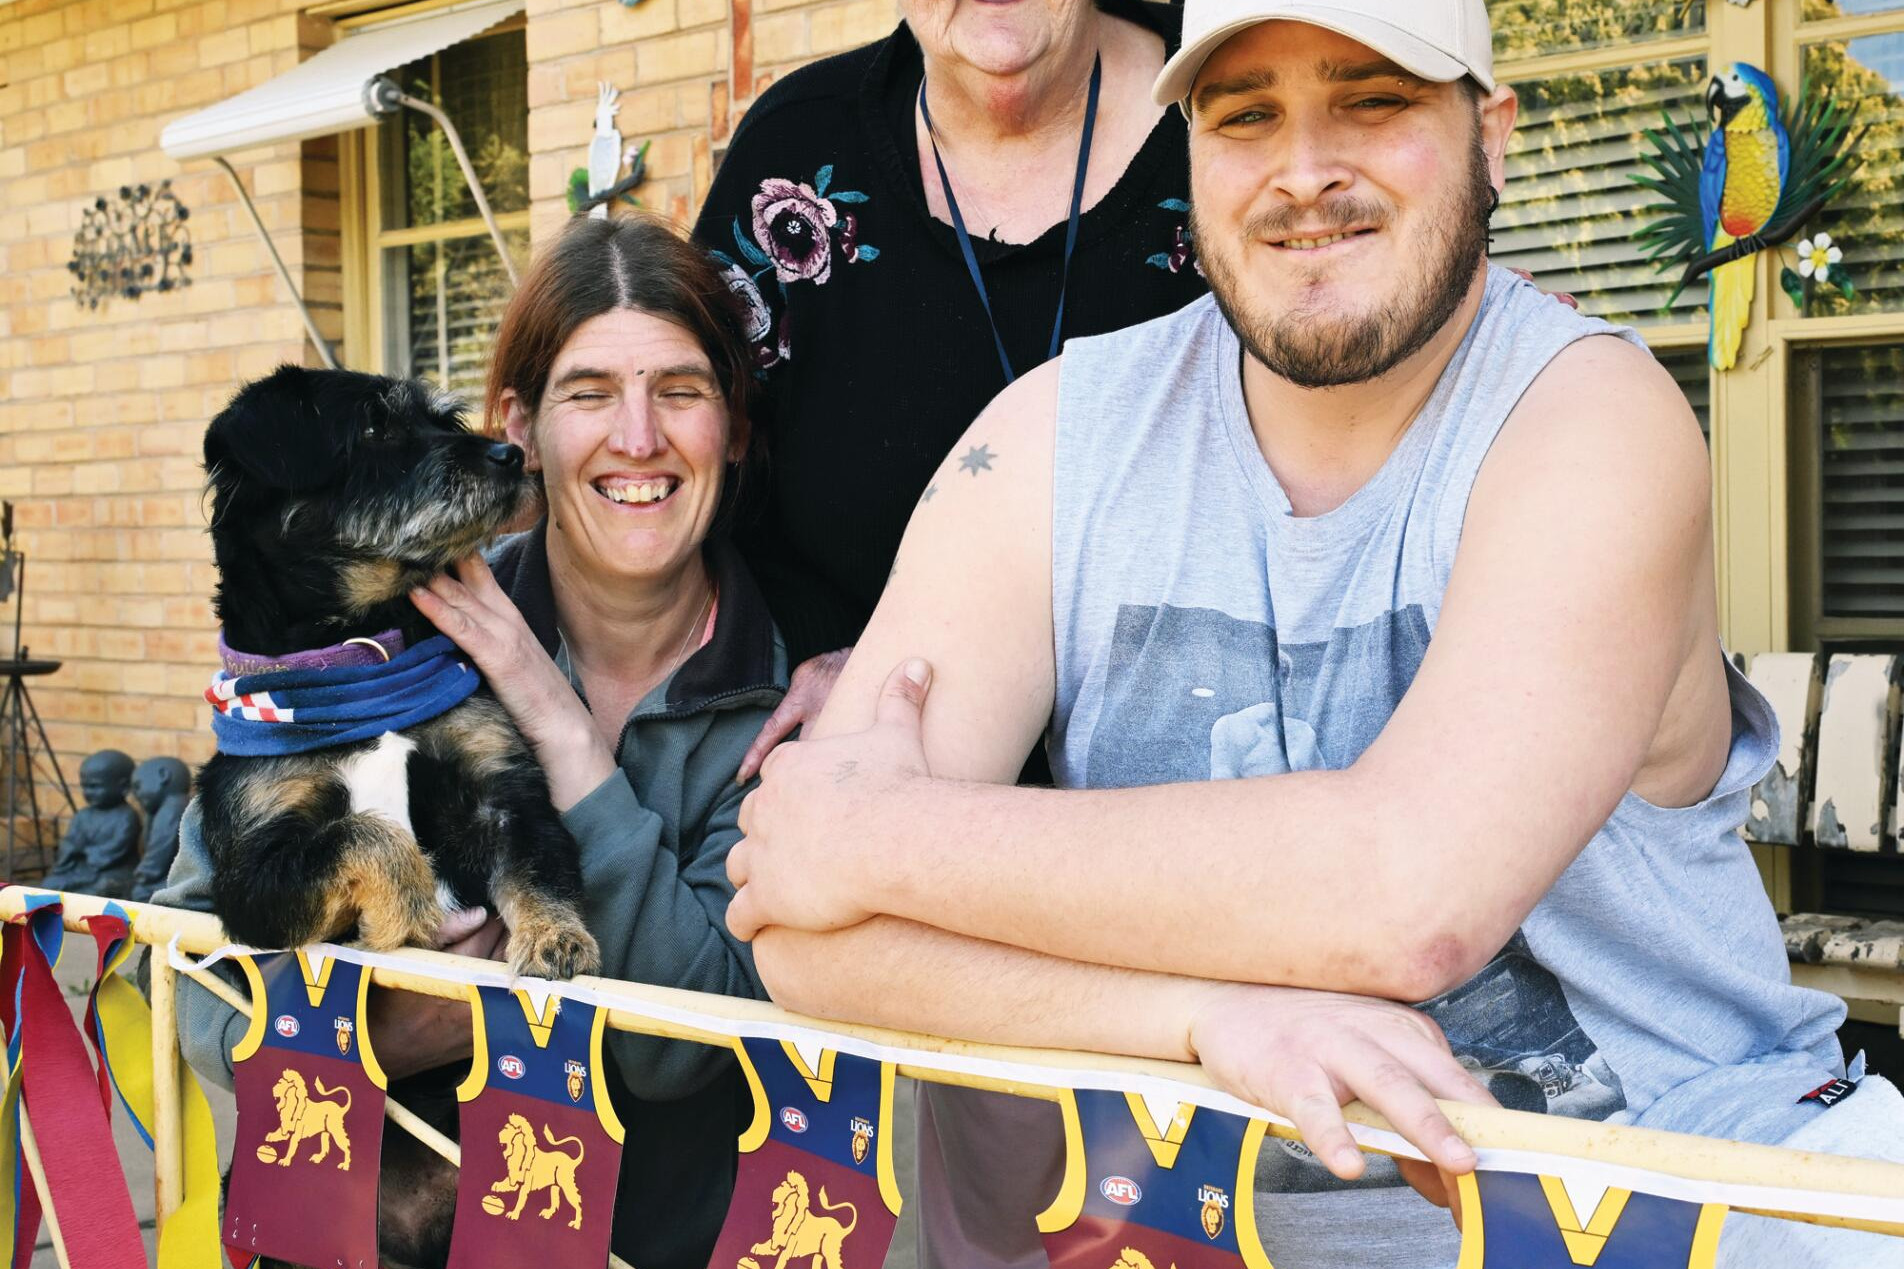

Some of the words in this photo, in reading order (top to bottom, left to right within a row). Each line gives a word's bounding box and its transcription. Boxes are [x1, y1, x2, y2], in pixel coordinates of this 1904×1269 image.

[277, 1019, 298, 1033] AFL
[501, 1060, 523, 1075] AFL
[784, 1111, 806, 1129] AFL
[1105, 1181, 1139, 1200] AFL
[1197, 1187, 1229, 1209] LIONS
